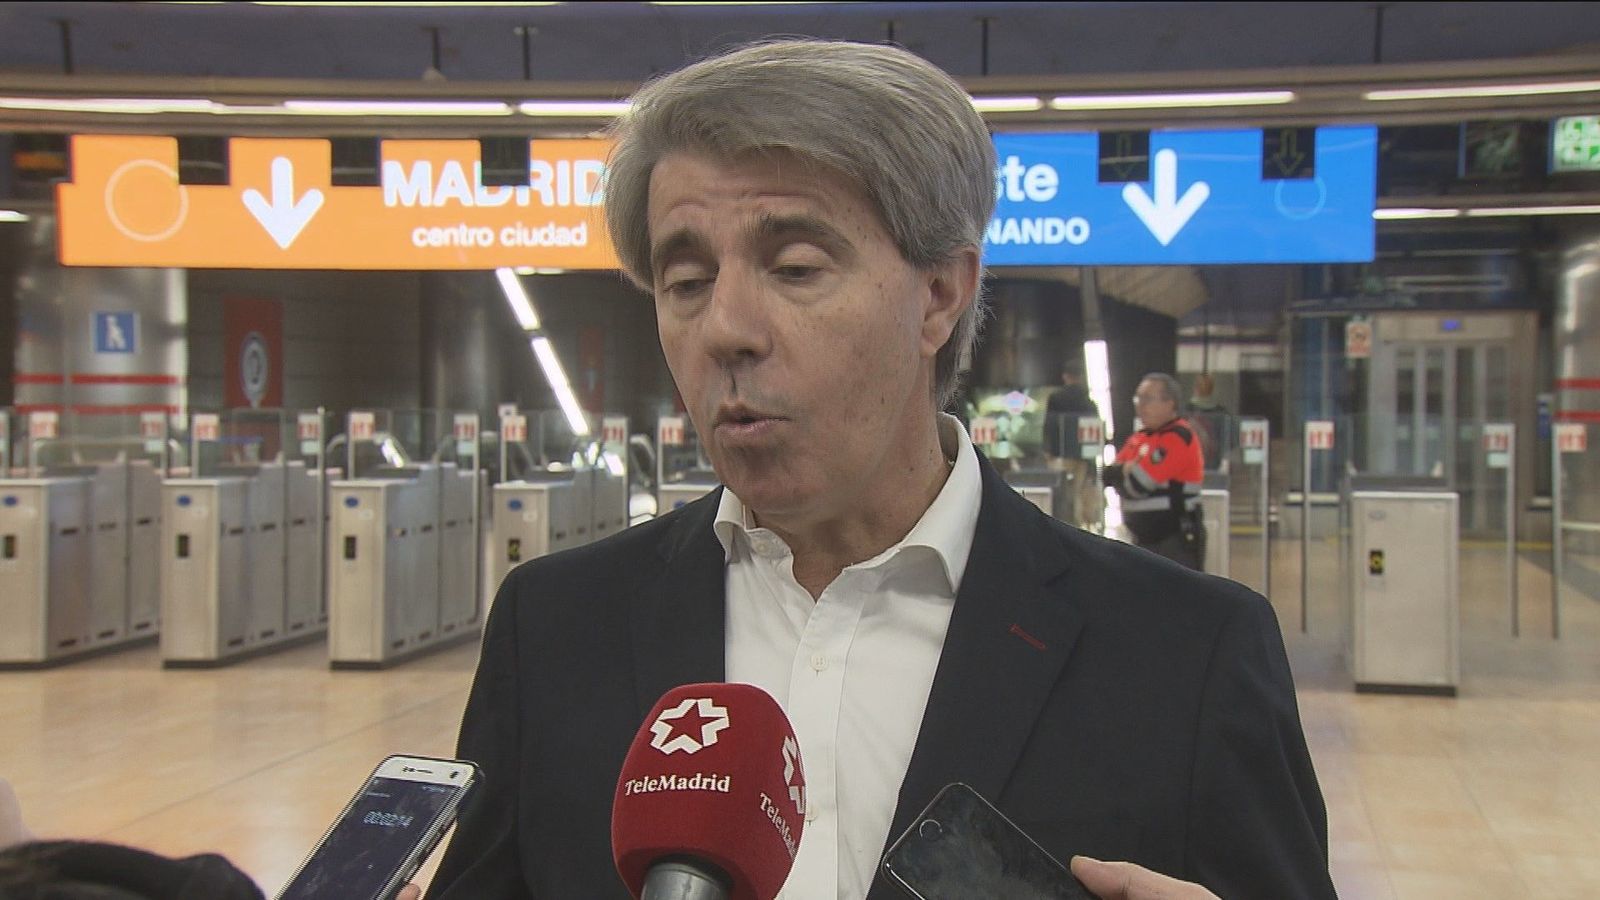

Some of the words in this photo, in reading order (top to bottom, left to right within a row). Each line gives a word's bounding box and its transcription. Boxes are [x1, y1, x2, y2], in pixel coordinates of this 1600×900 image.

[412, 224, 494, 247] centro
[500, 222, 587, 247] ciudad
[625, 773, 730, 796] TeleMadrid
